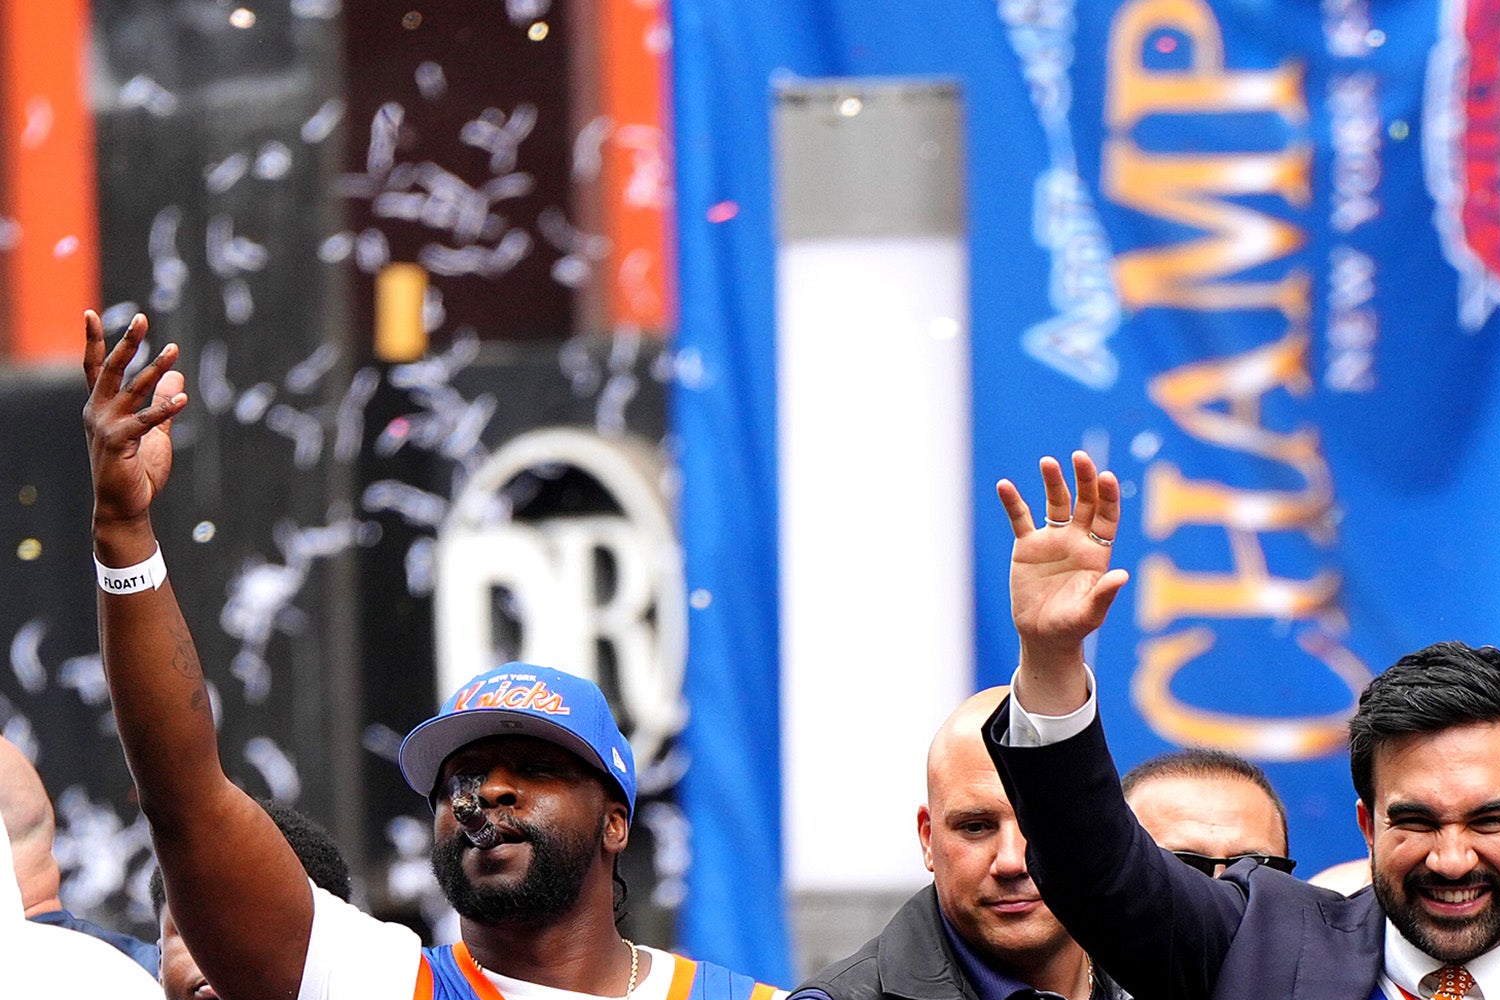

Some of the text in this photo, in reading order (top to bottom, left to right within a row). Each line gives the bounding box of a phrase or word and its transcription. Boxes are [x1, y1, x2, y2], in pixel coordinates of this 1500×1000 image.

[1325, 247, 1376, 391] NEW
[104, 575, 145, 589] FLOAT 1
[453, 681, 570, 715] Knicks
